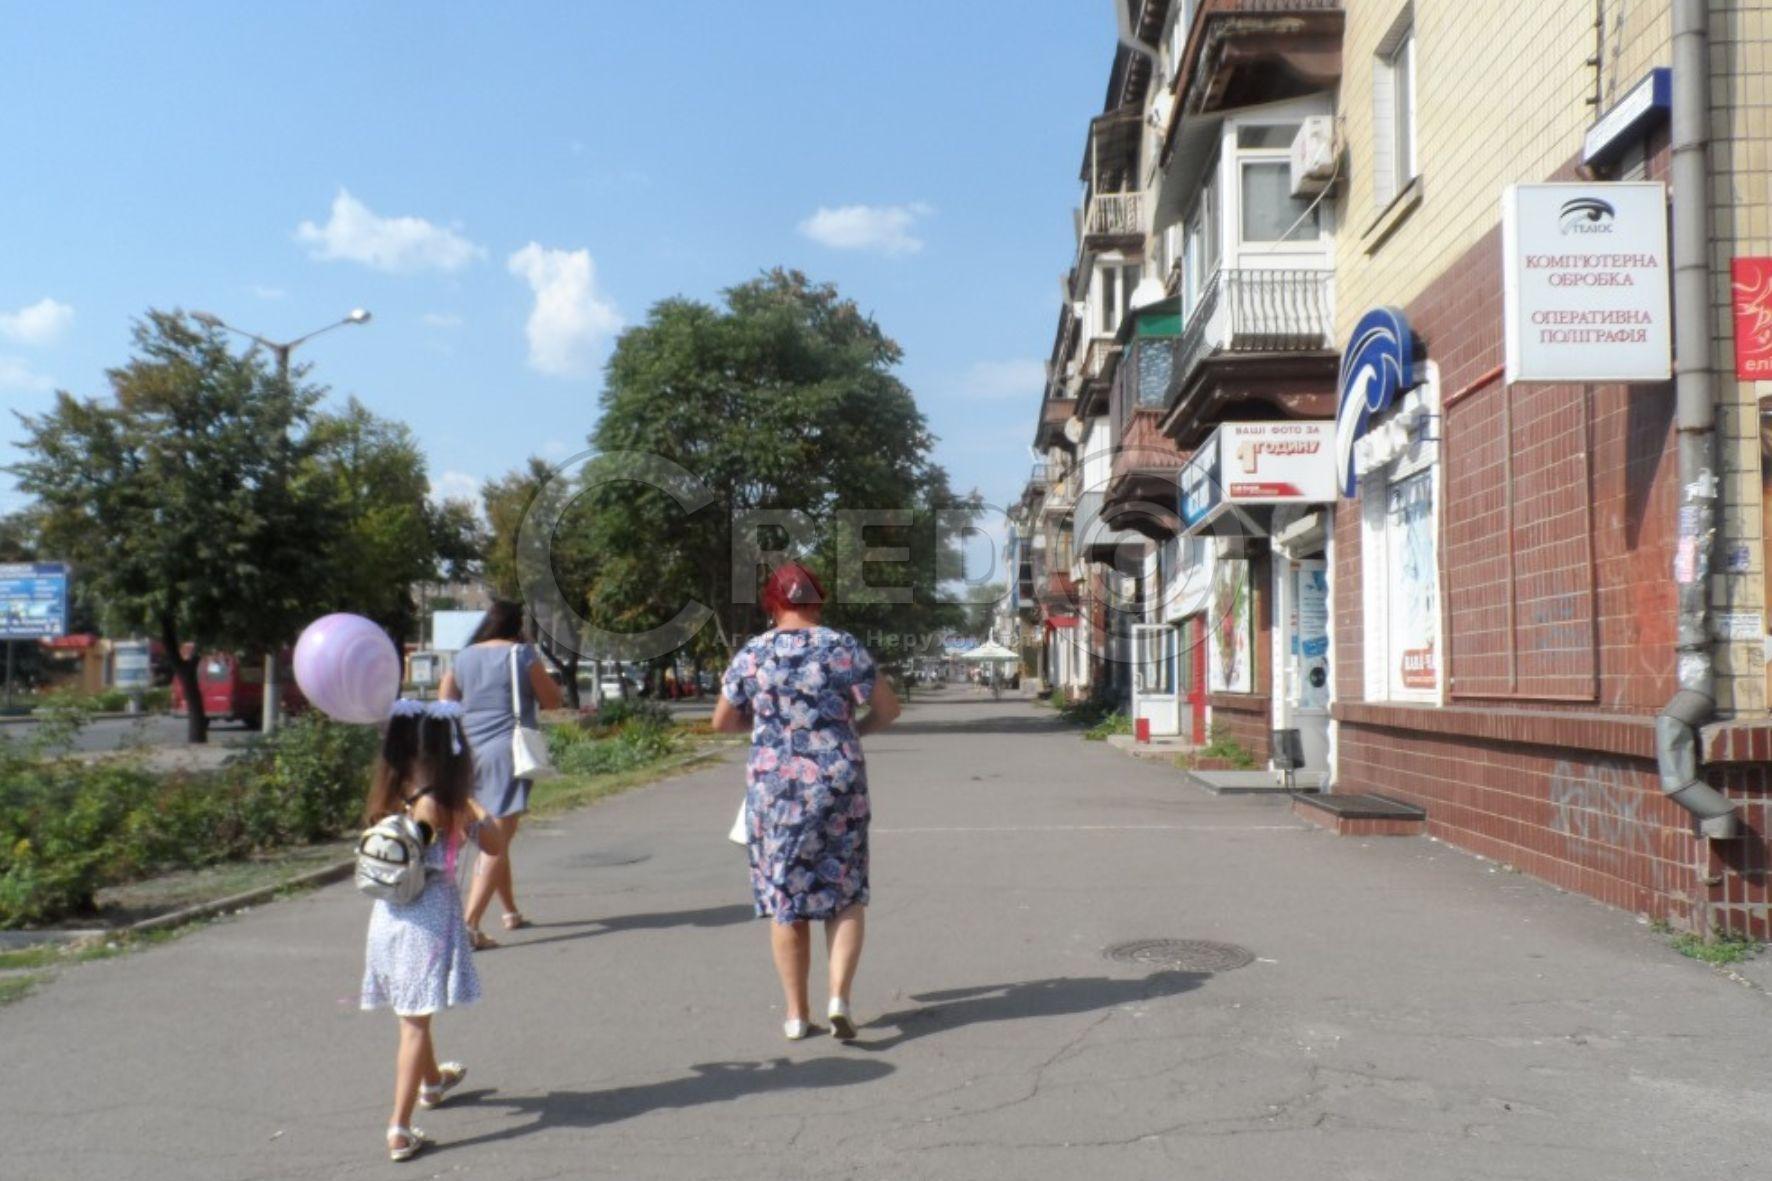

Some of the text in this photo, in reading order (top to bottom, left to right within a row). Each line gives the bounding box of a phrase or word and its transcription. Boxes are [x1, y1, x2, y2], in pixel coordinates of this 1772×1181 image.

[1547, 271, 1635, 287] ОБРОБКА
[1531, 309, 1653, 325] ОПЕРАТИВНА
[1540, 328, 1648, 343] ПОЛІГРАФІЯ
[1271, 426, 1302, 435] ФОТО
[1306, 425, 1320, 434] ЗА
[1255, 440, 1321, 456] ГОДИНУ
